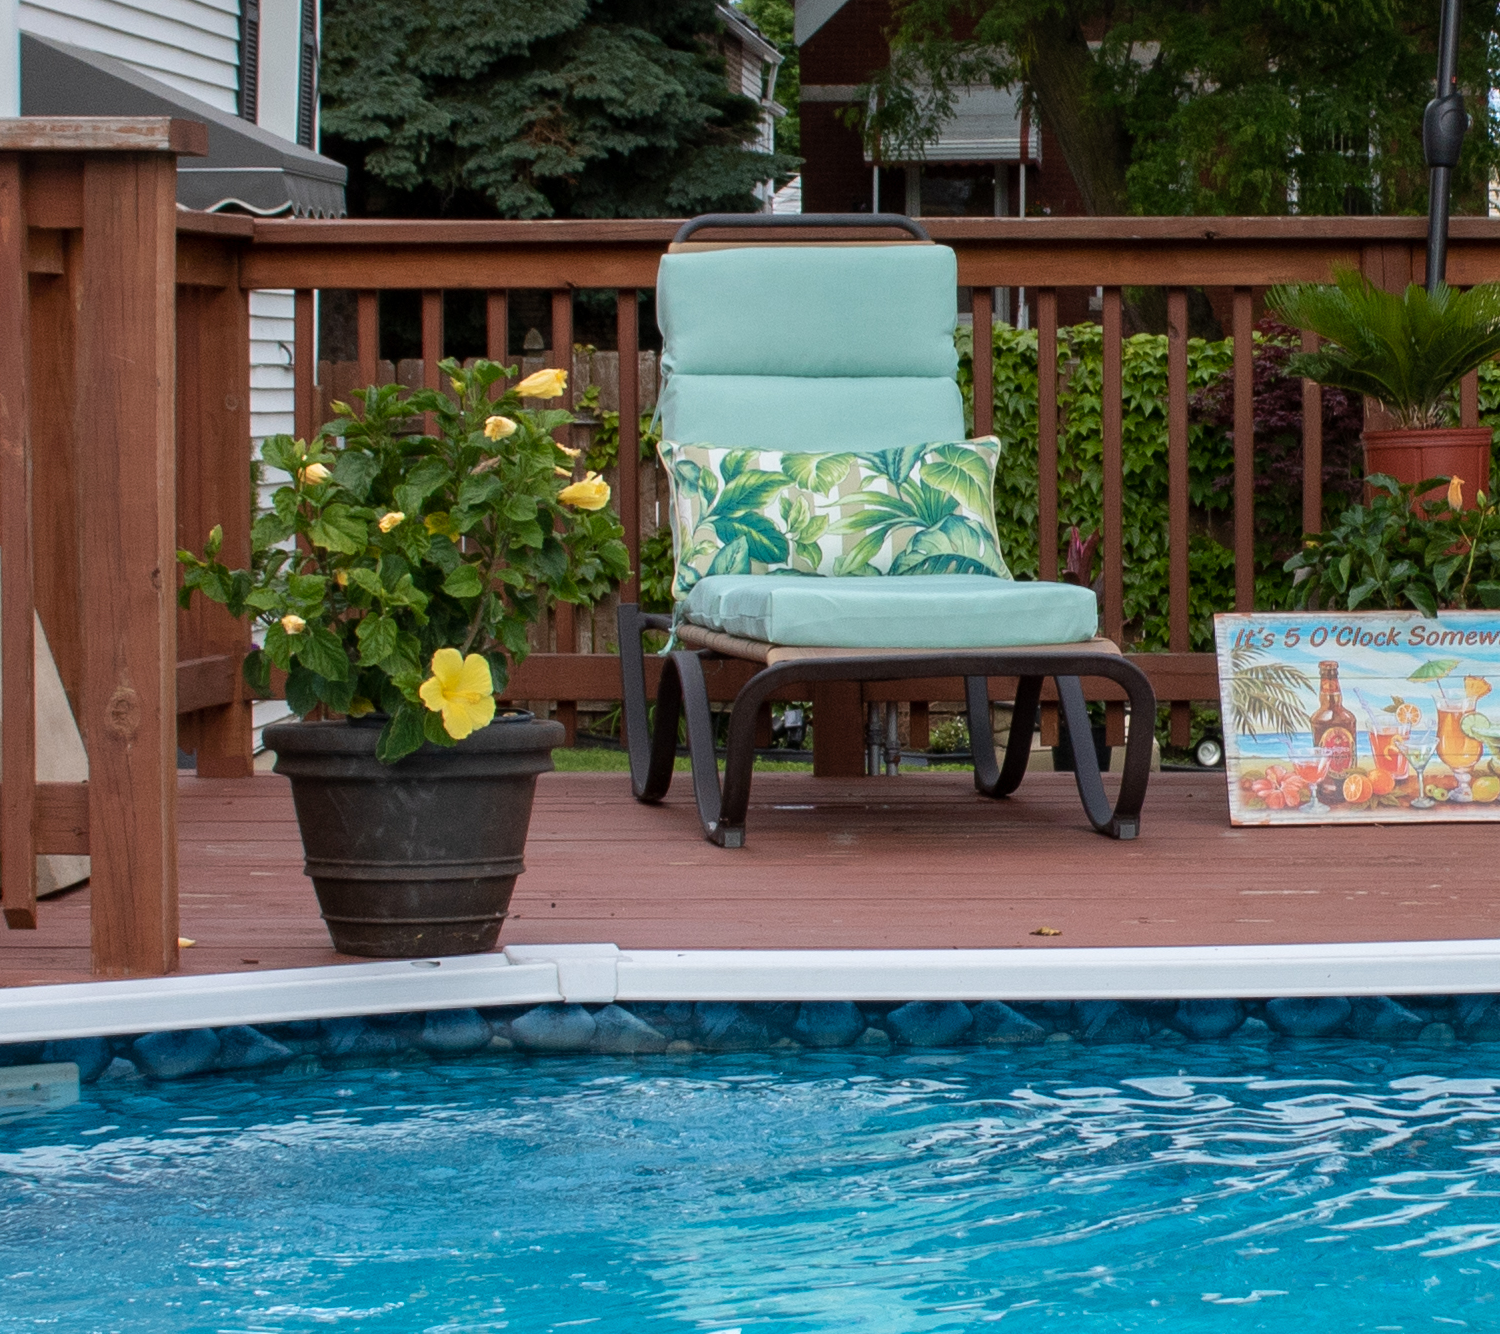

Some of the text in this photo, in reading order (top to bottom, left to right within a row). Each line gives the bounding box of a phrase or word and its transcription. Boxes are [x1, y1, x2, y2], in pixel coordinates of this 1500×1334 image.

[1235, 627, 1275, 648] It's
[1284, 627, 1301, 648] 5
[1309, 625, 1402, 648] O'Clock
